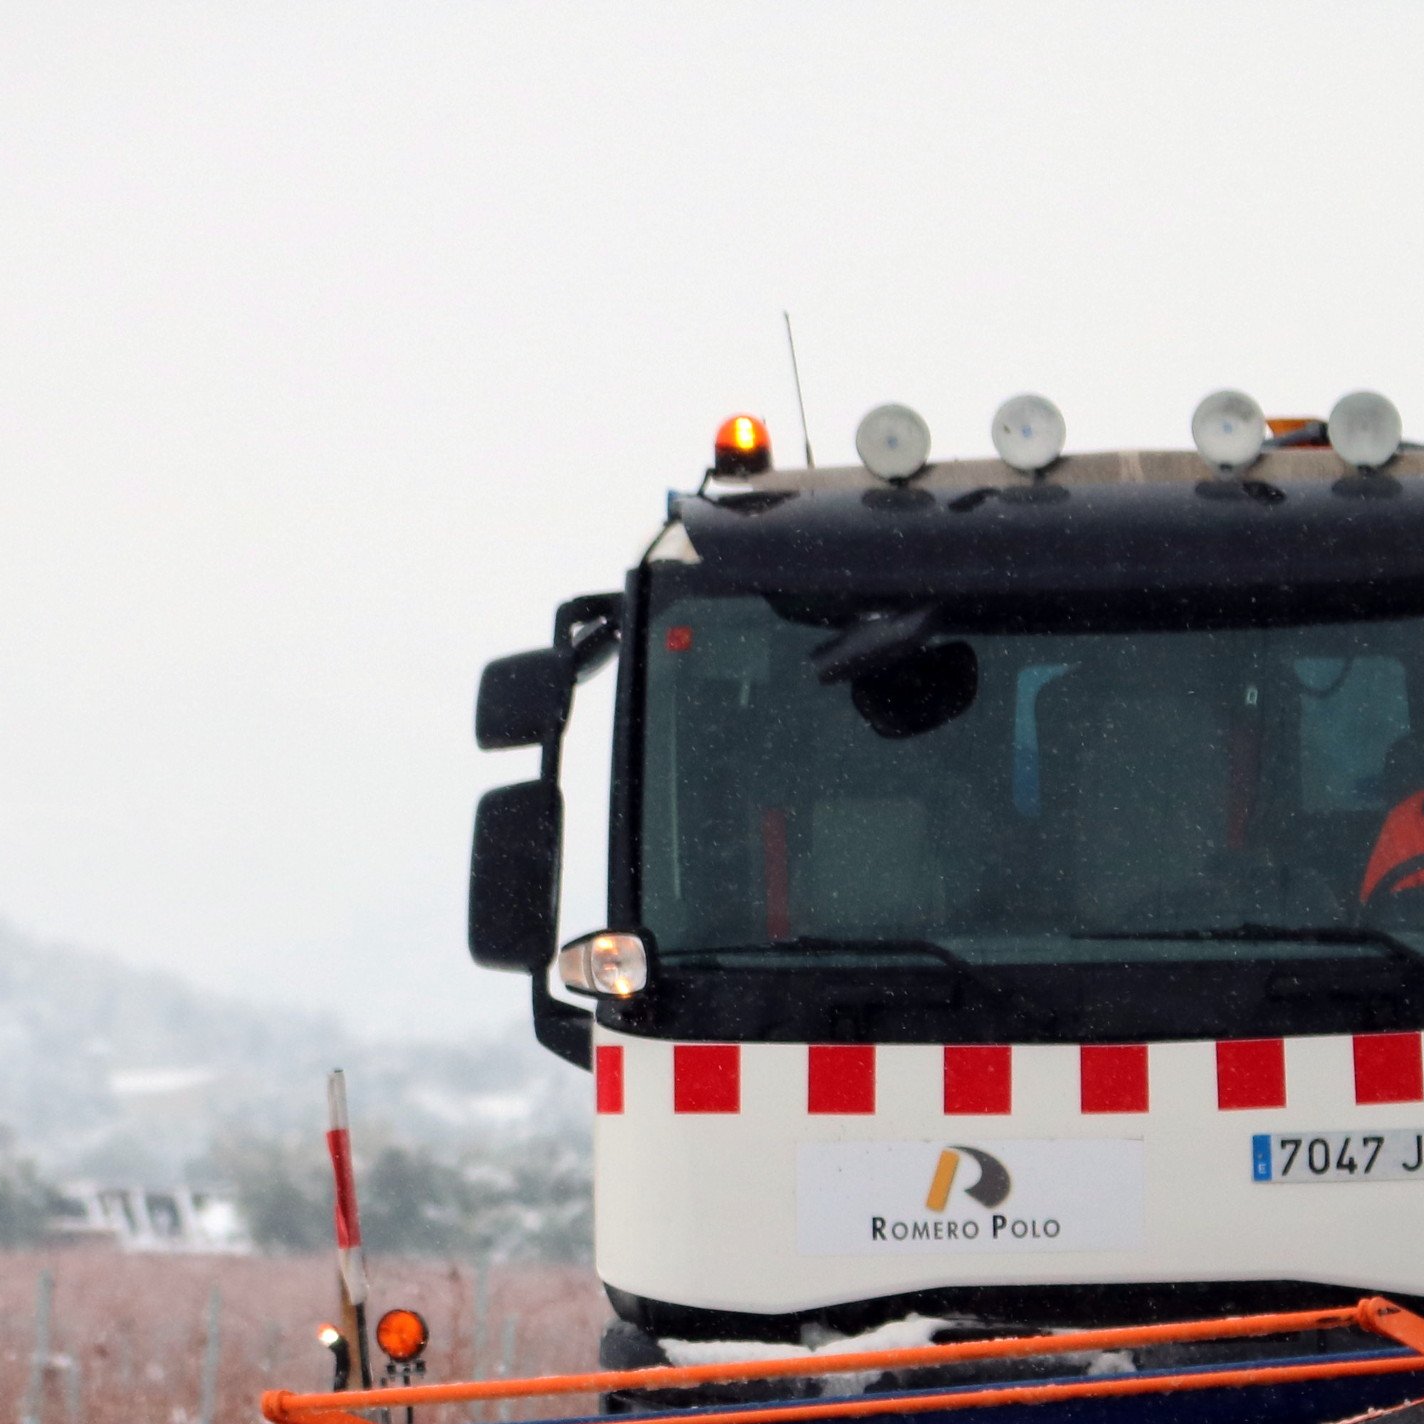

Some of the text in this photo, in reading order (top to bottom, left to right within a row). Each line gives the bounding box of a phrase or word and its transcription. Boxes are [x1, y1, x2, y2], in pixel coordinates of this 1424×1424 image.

[1281, 1136, 1385, 1176] 7047
[872, 1214, 1061, 1241] ROMERO POLO
